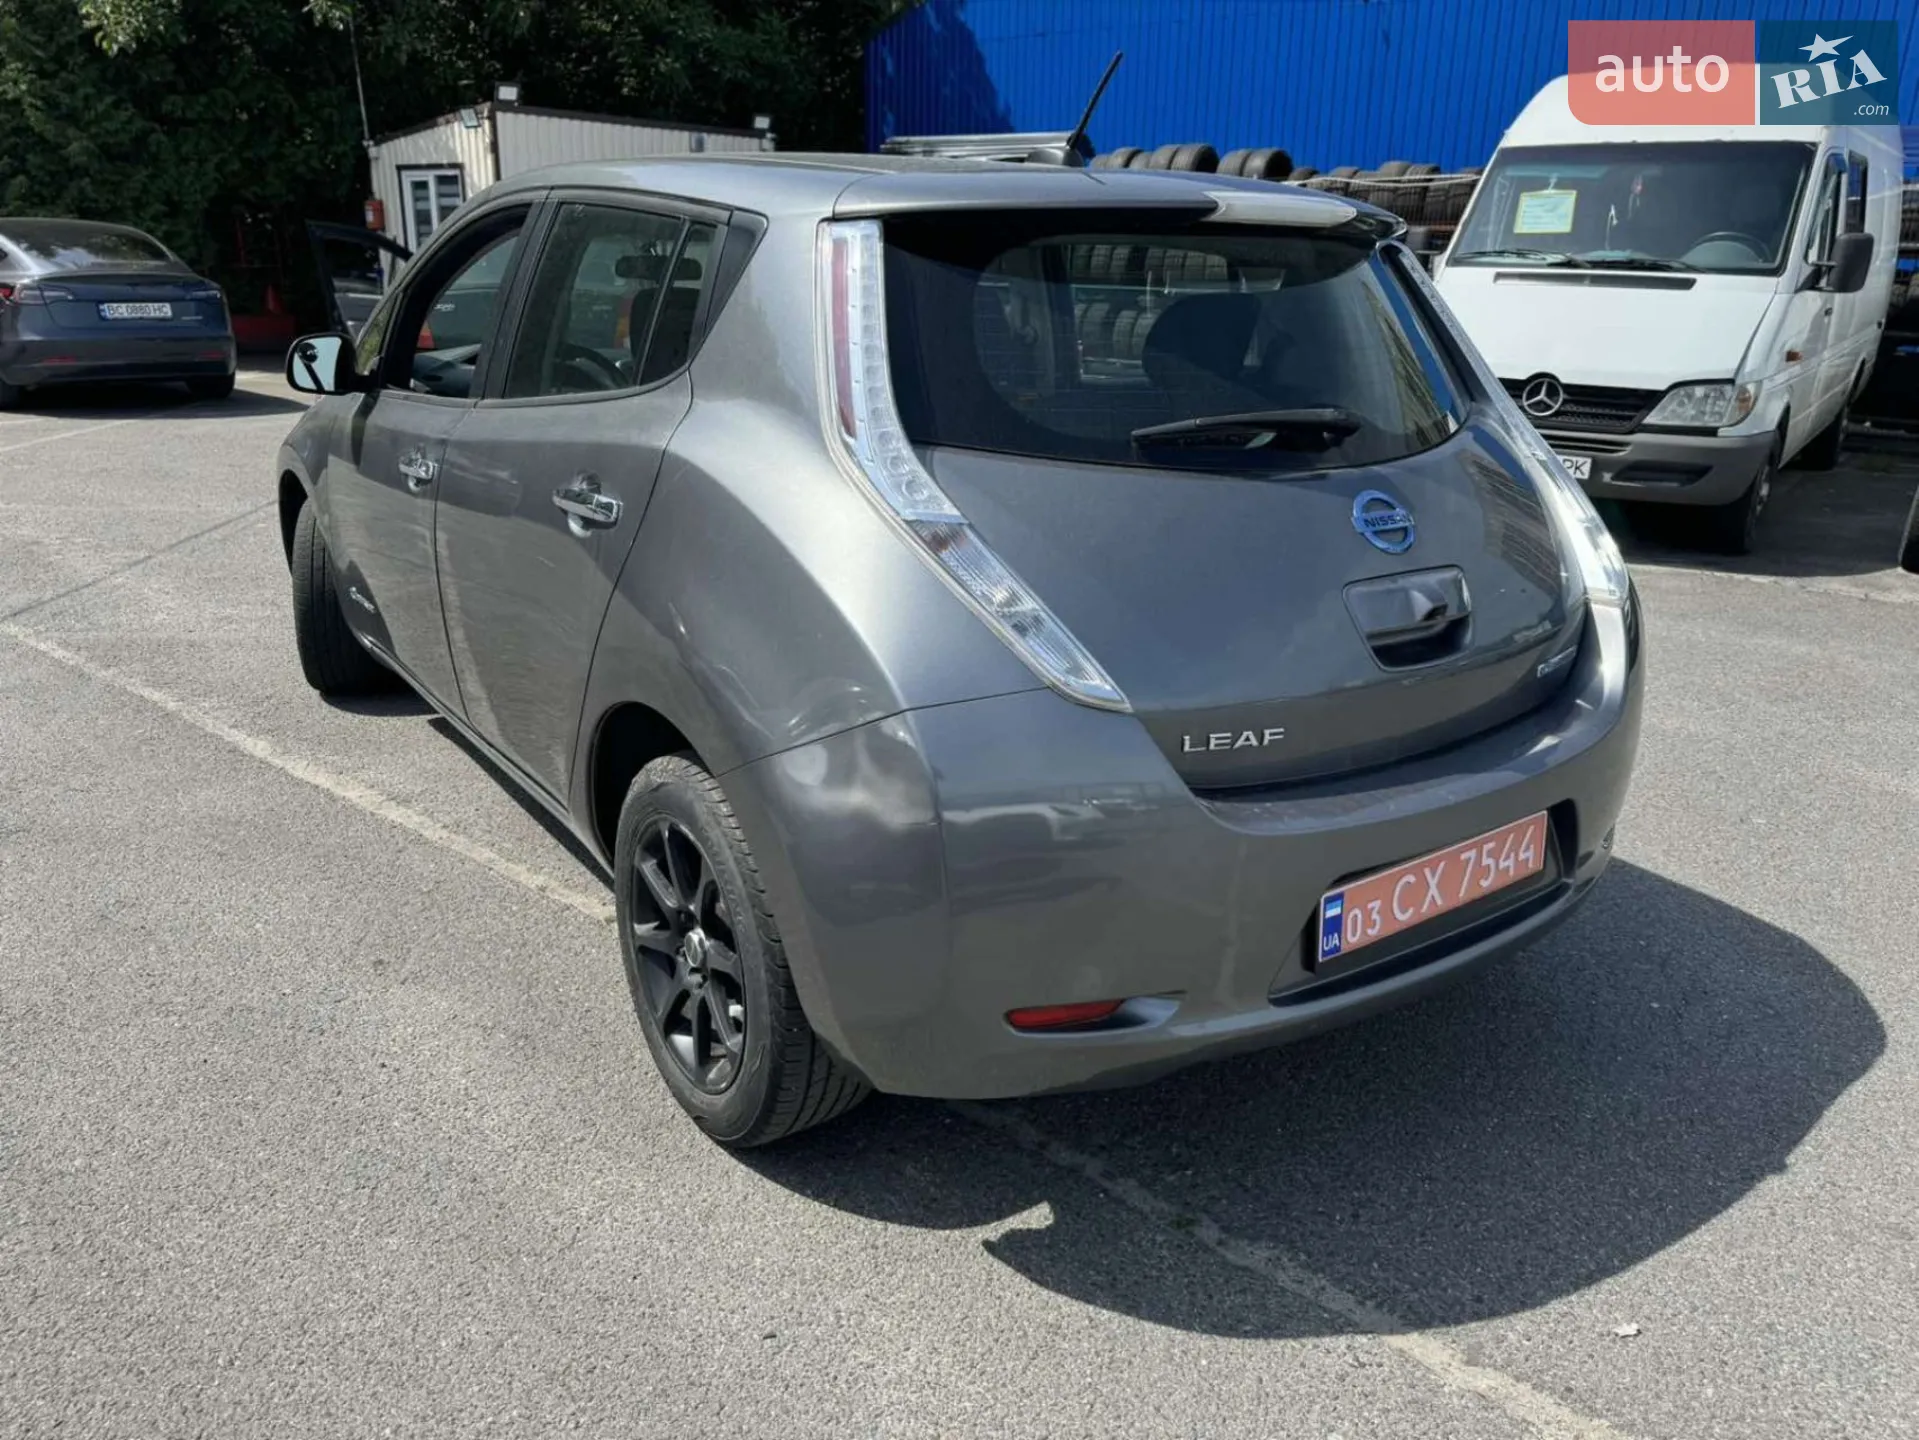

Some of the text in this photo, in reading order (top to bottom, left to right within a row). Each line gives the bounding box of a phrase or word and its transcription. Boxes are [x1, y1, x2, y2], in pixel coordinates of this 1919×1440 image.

[1363, 513, 1411, 528] NISSAN
[1182, 727, 1285, 753] LEAF
[1346, 824, 1536, 943] 03 CX 7544
[1322, 932, 1340, 951] UA
